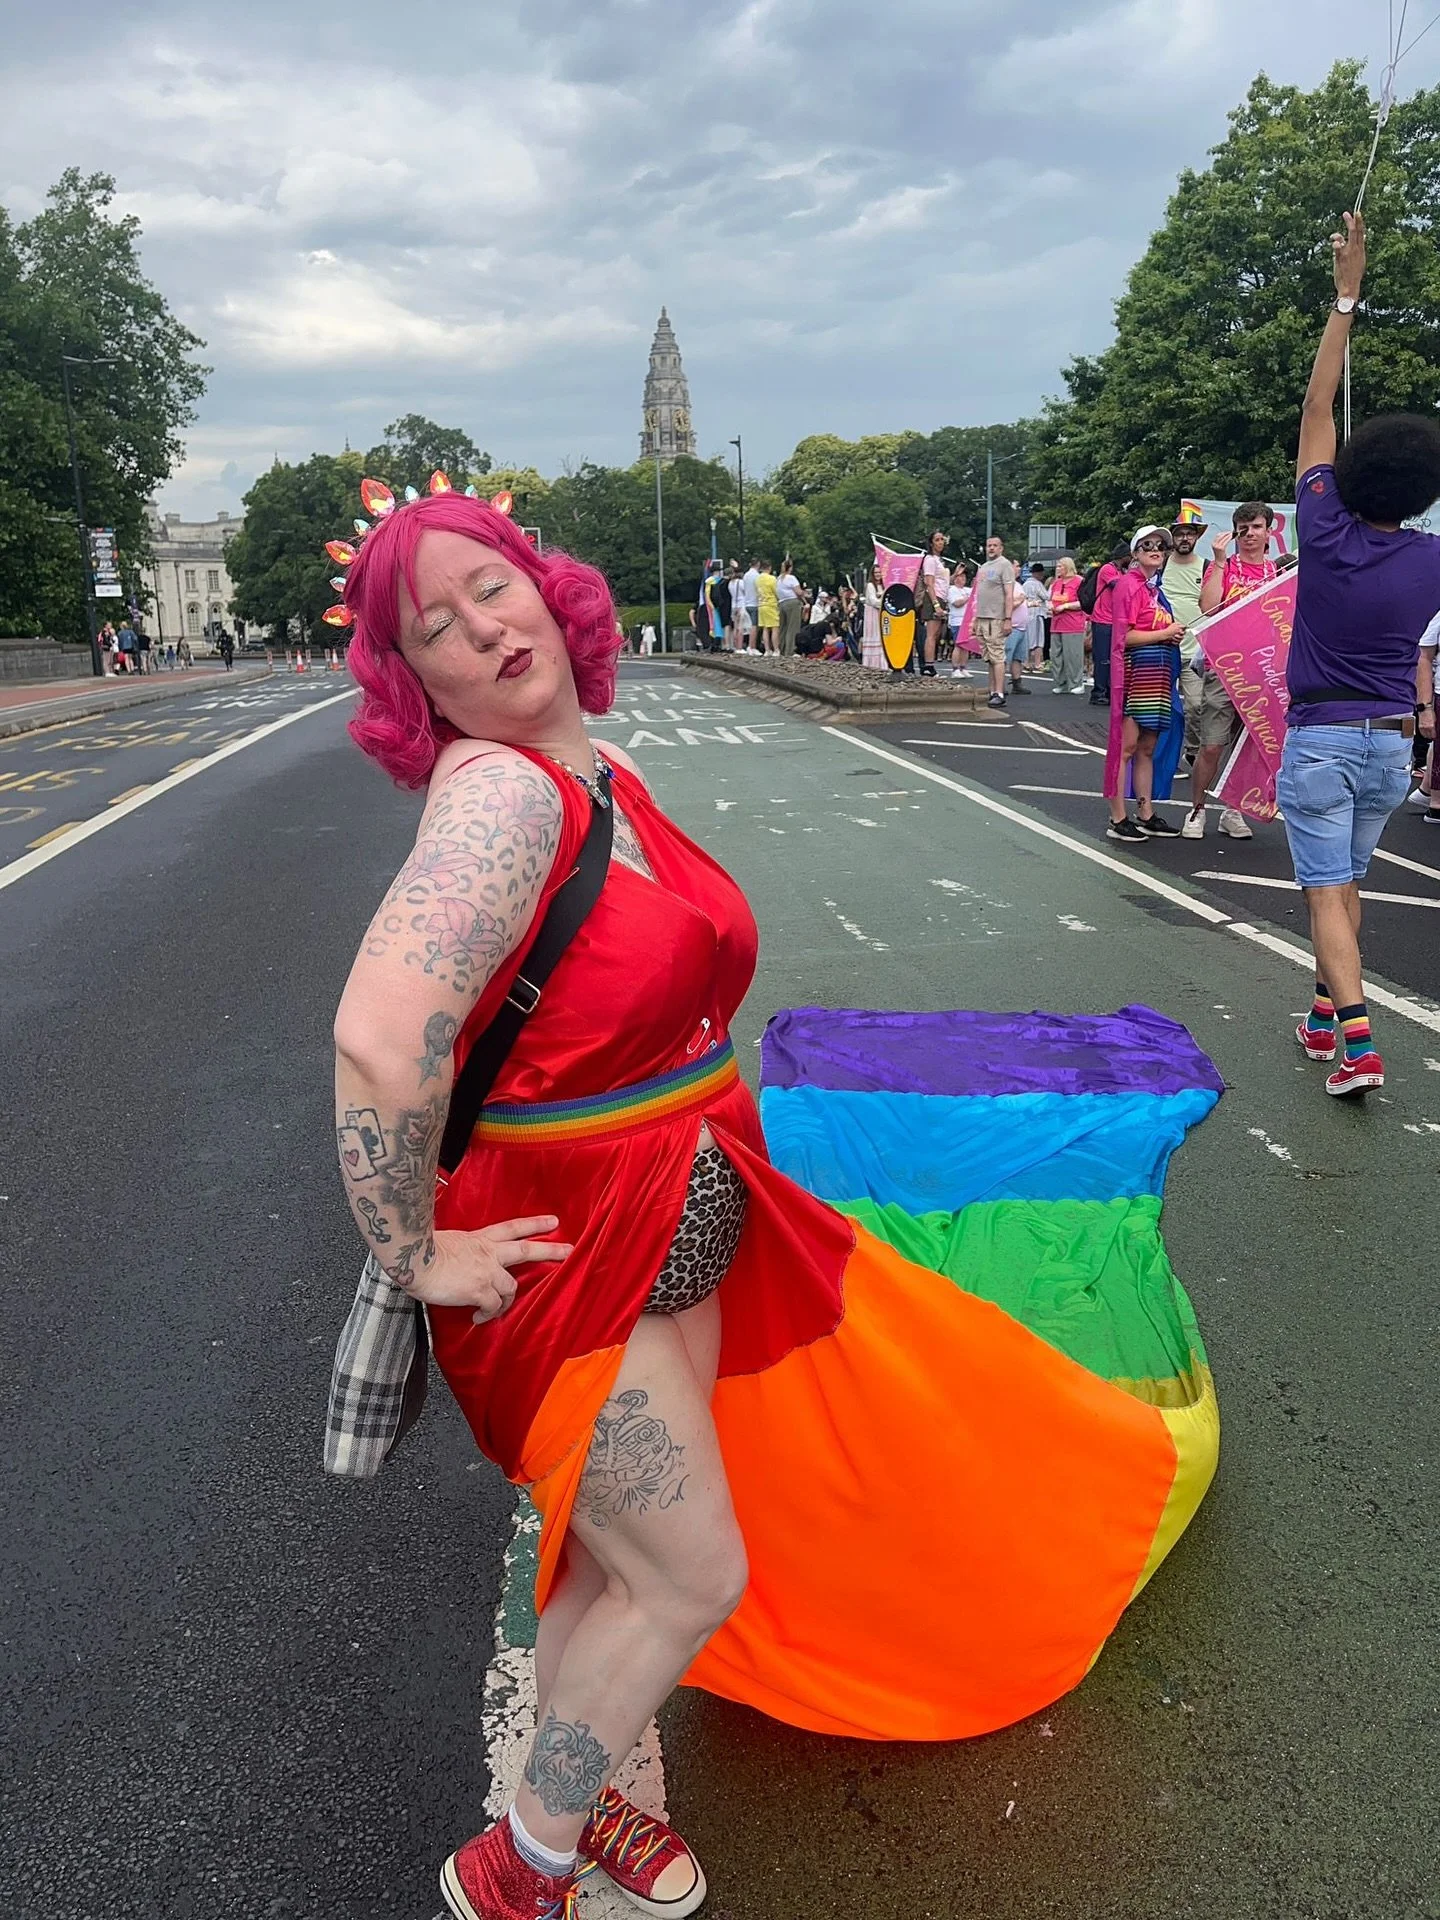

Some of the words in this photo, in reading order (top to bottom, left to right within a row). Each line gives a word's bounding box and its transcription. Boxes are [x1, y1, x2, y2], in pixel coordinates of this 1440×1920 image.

[1250, 645, 1286, 687] Pride
[582, 707, 737, 725] BUS
[1215, 652, 1261, 698] Civil
[1240, 697, 1281, 754] Service
[626, 722, 808, 749] ANE
